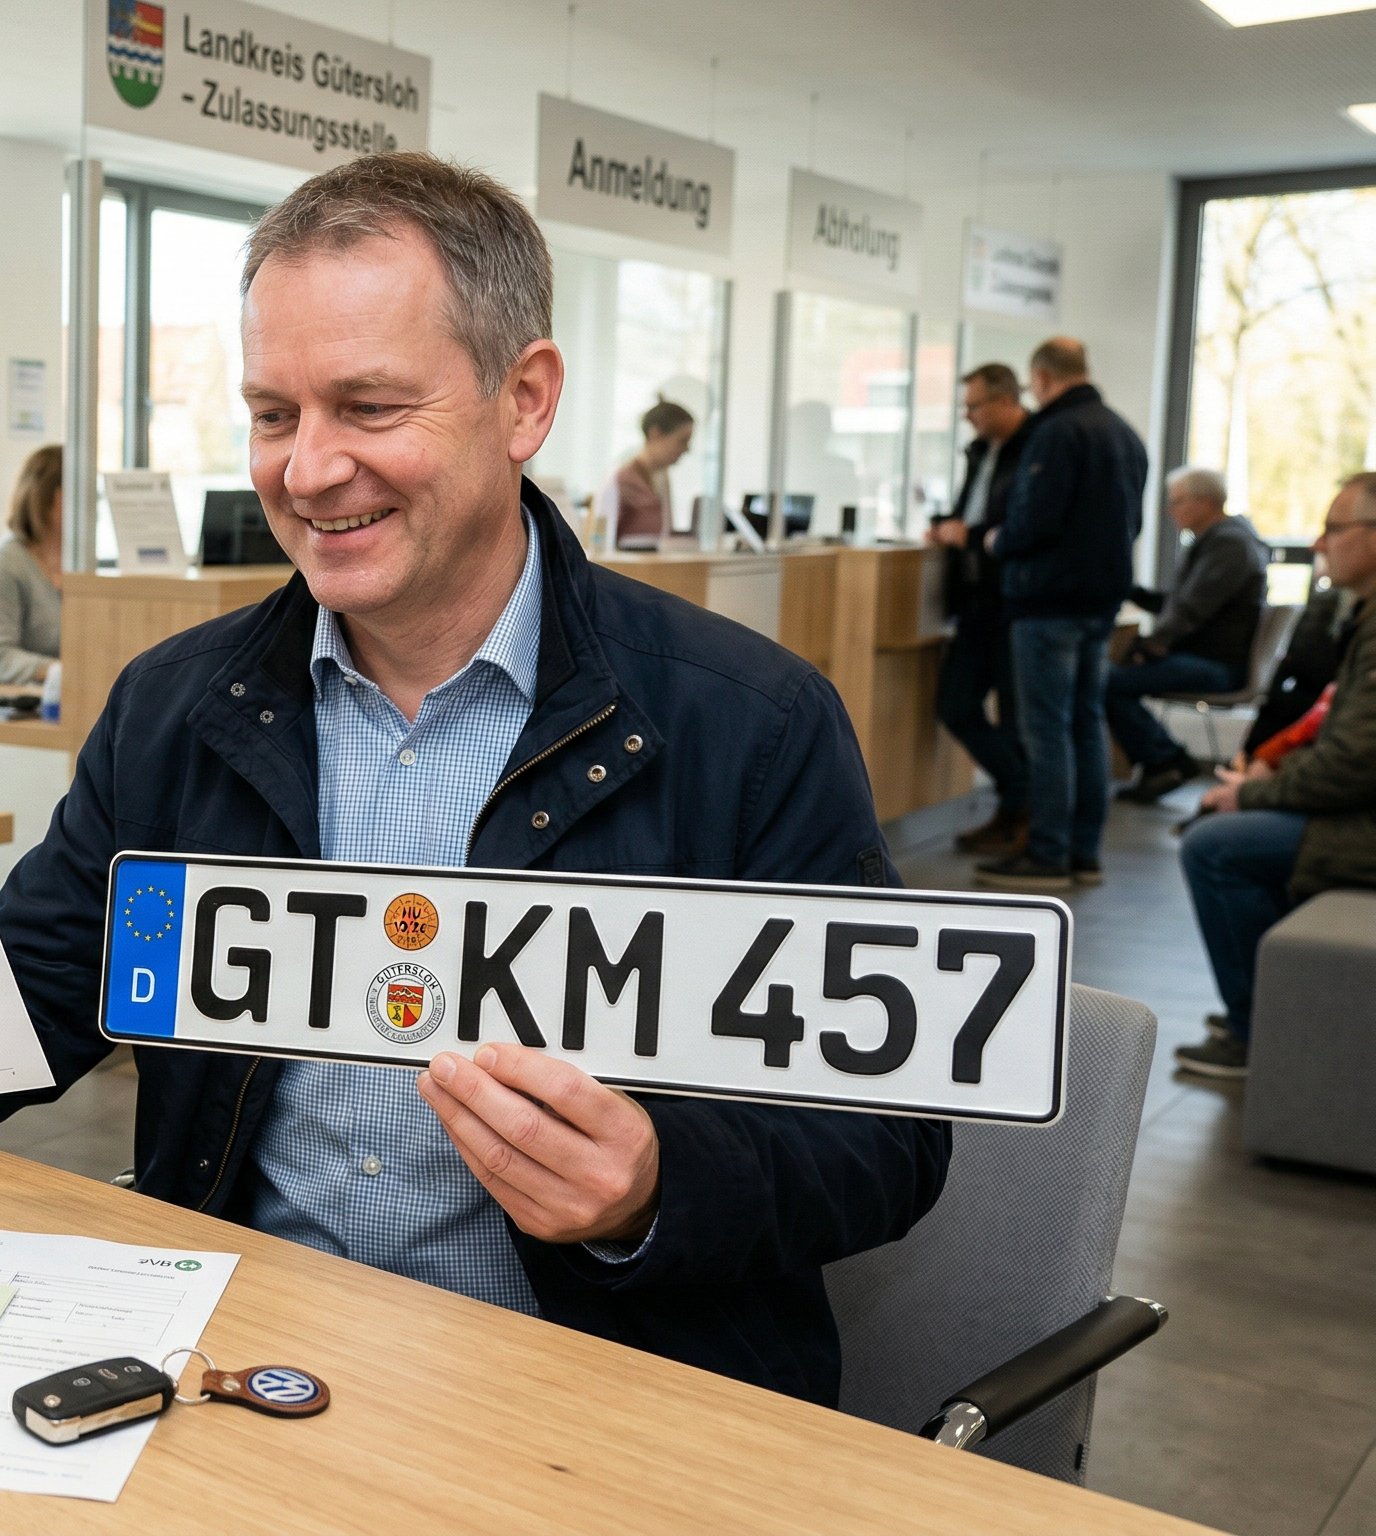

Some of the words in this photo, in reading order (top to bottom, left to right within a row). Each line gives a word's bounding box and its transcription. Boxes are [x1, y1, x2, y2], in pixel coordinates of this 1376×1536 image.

[183, 15, 306, 83] Landkreis
[311, 51, 419, 112] Gütersloh
[200, 79, 398, 153] Zulassungsstelle
[566, 137, 712, 230] Anmeldung
[130, 967, 156, 1003] D
[192, 886, 368, 1030] GT
[456, 900, 666, 1058] KM
[709, 916, 1038, 1086] 457
